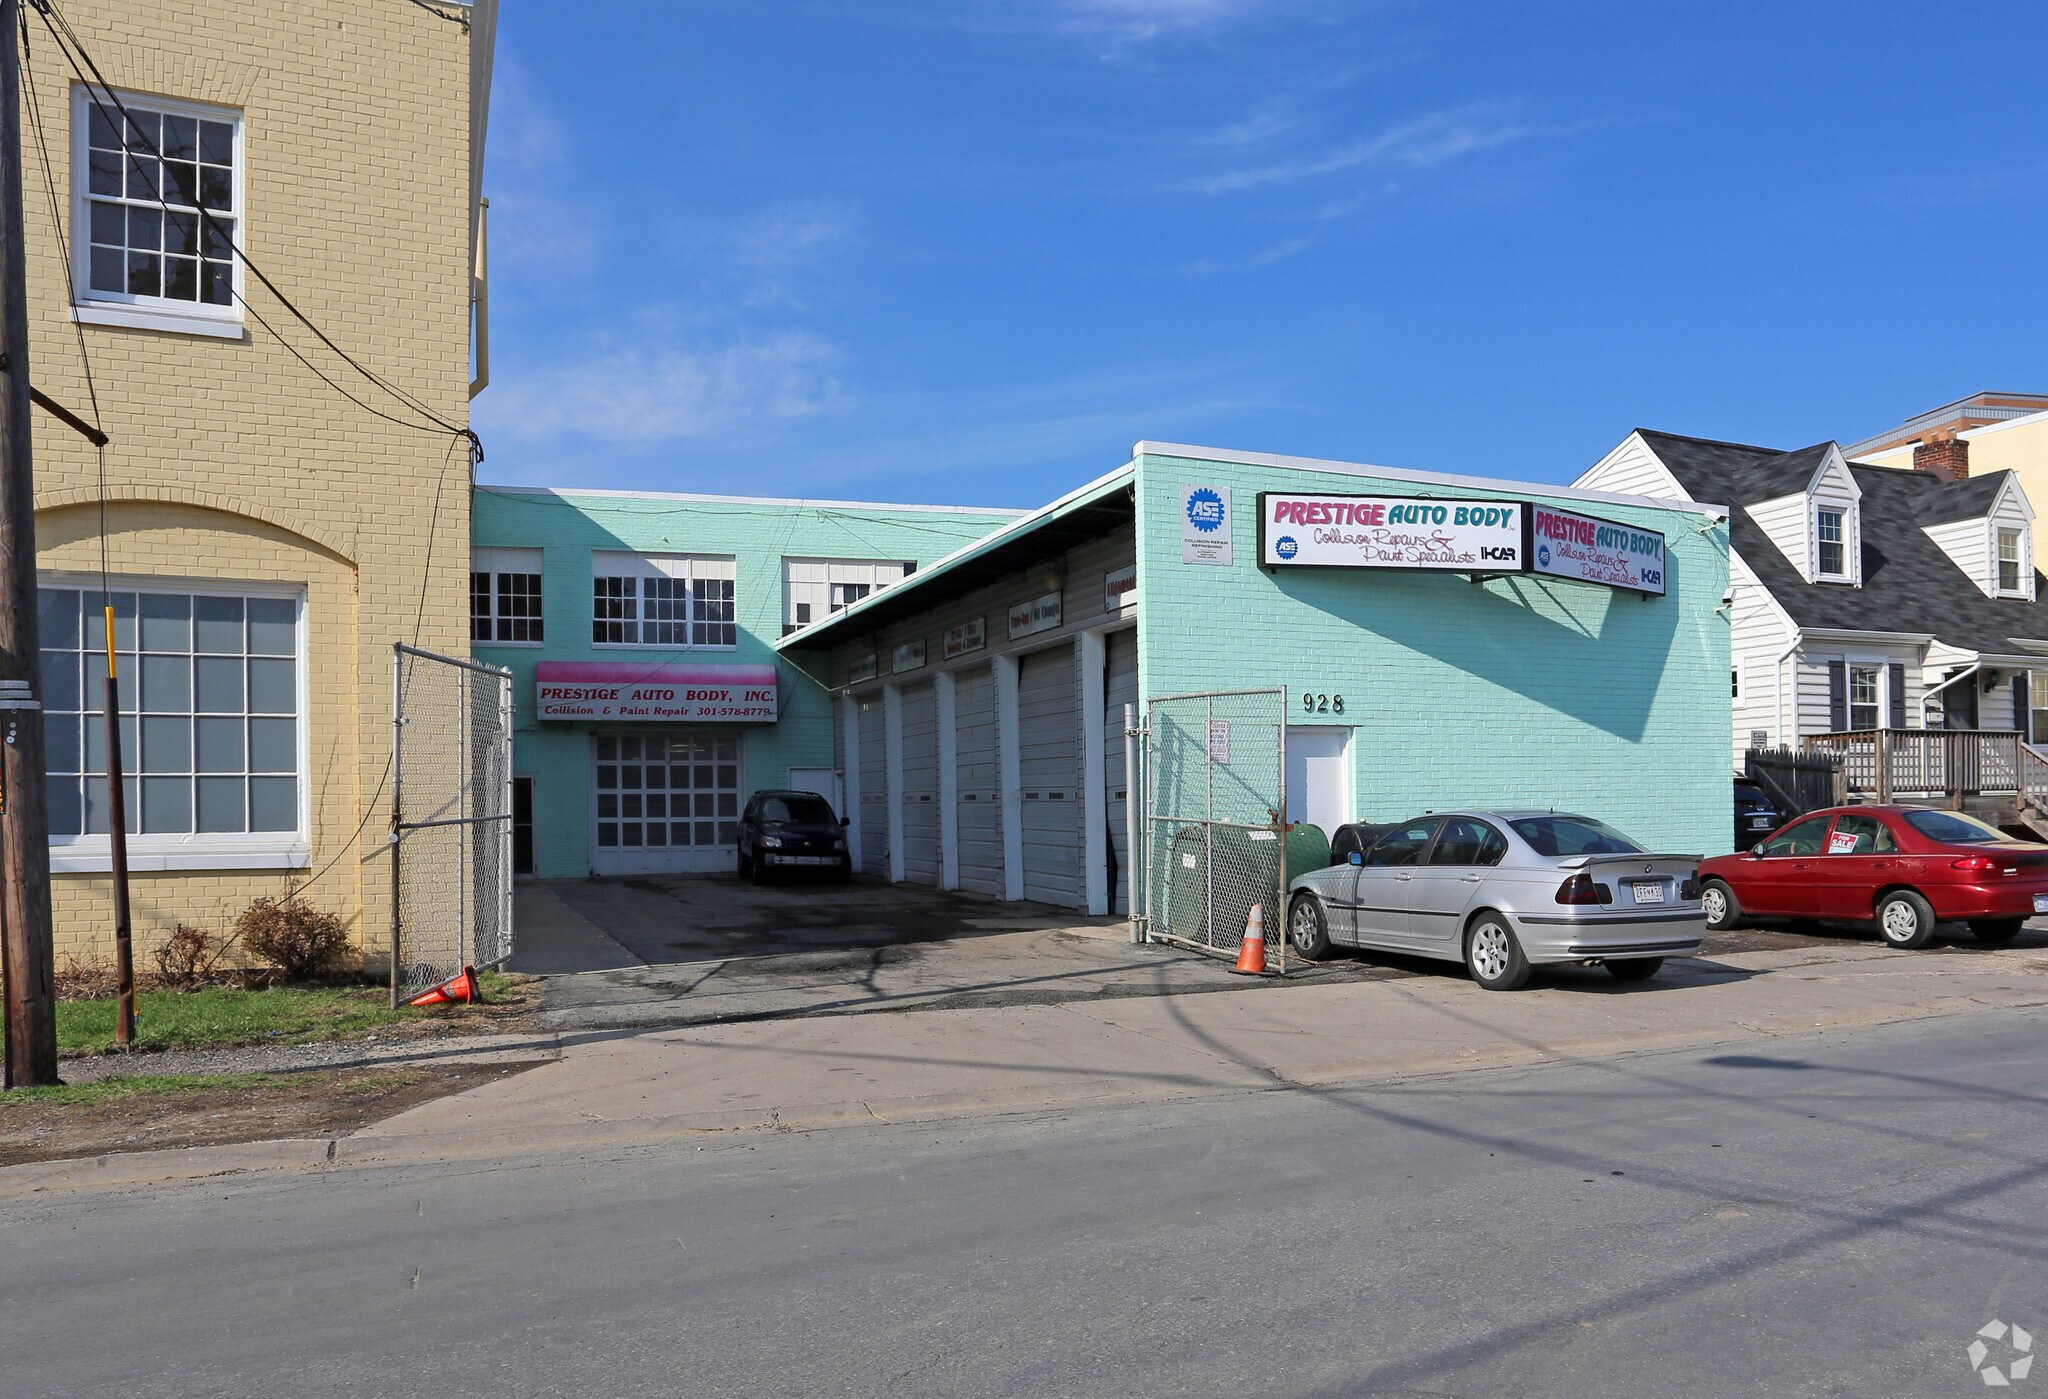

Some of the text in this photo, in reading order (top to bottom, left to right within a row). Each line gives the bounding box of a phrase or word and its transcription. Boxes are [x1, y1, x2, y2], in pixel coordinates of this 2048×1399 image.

[1192, 501, 1219, 517] ASE
[1274, 501, 1386, 526] PRESTIGE
[1388, 504, 1448, 526] AUTO
[1453, 506, 1514, 529] BODY
[1314, 527, 1371, 545] Collision
[1372, 528, 1426, 550] Repairs
[1536, 511, 1661, 559] PRESTIGE AUTO BODY
[1359, 545, 1476, 567] Paint Specialists
[1556, 541, 1587, 561] Collision
[1586, 547, 1614, 567] Repairs
[1580, 562, 1639, 586] Paint Specialists
[540, 688, 774, 703] PRESTIGE AUTO BODY, INC.
[1302, 692, 1344, 712] 928
[544, 705, 770, 717] Collision & Paint Repair 301-578-8779
[1832, 839, 1853, 849] SALE
